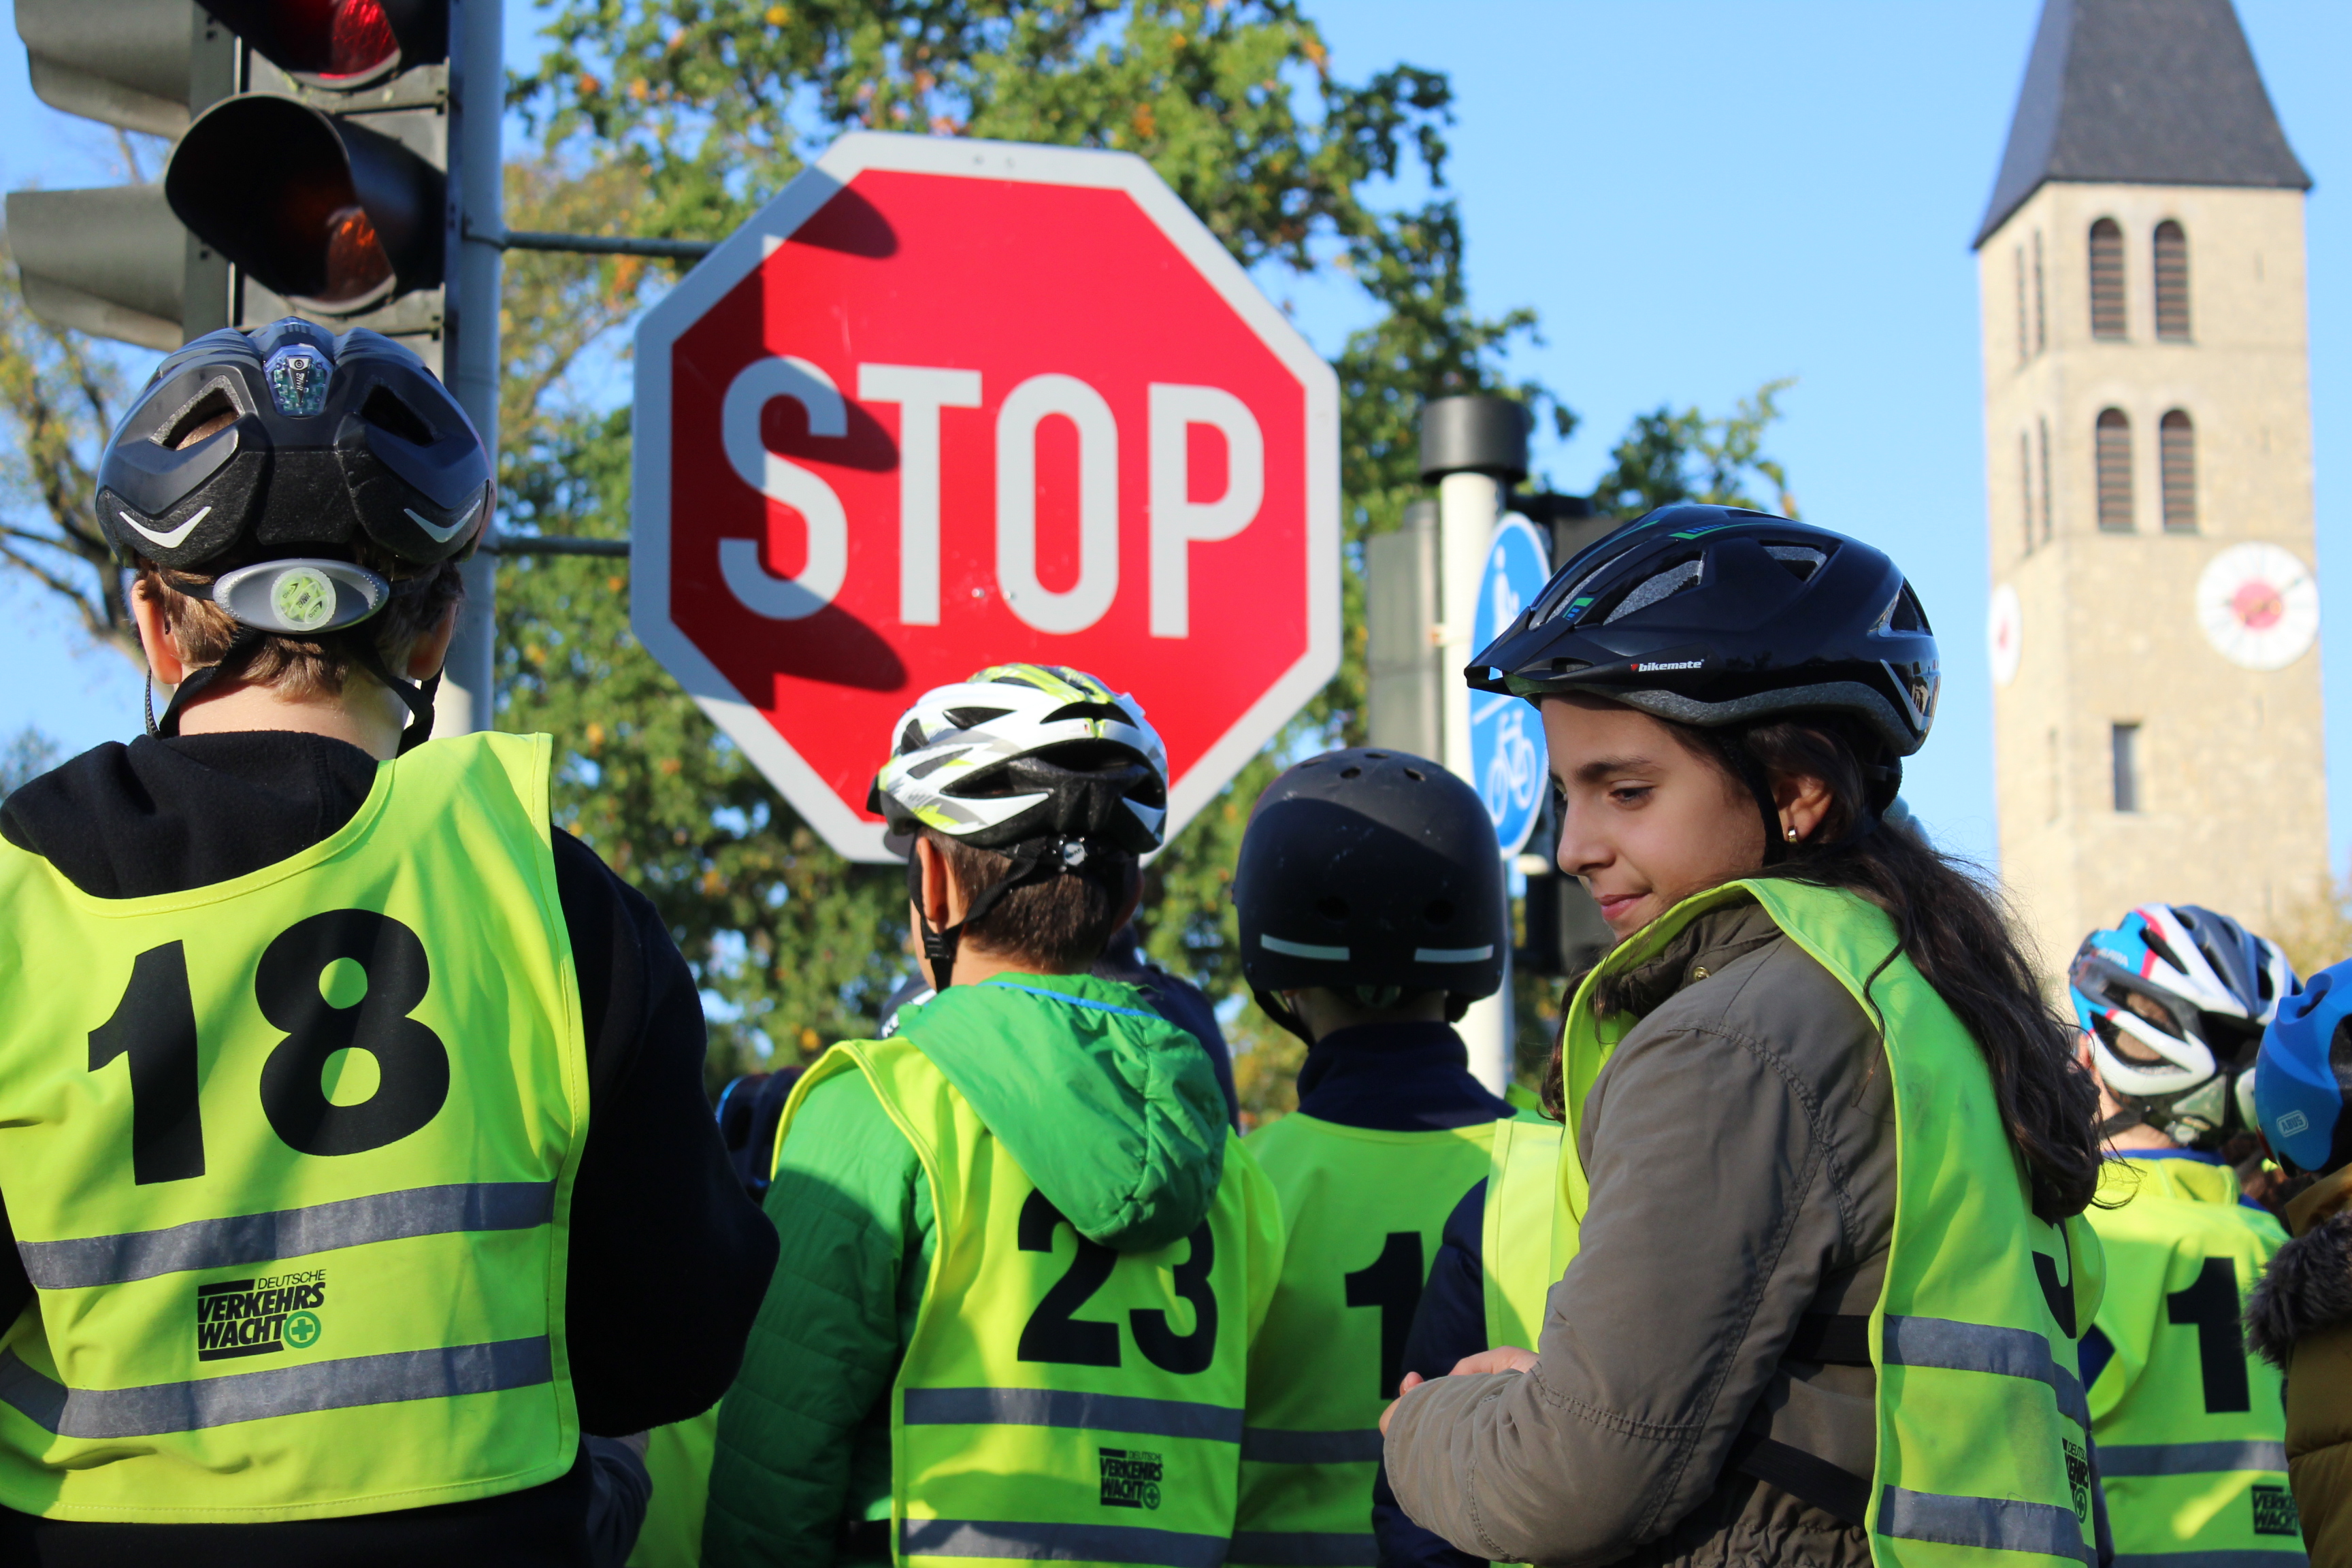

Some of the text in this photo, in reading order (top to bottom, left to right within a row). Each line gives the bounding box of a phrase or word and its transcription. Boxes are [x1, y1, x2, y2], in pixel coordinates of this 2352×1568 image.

[718, 355, 1265, 639] STOP
[308, 606, 320, 618] Open
[1638, 660, 1702, 672] bikemate
[87, 908, 450, 1186] 18
[258, 1269, 327, 1290] DEUTSCHE
[1017, 1187, 1218, 1375] 23
[197, 1281, 326, 1323] VERKEHRS
[197, 1313, 288, 1350] WACHT
[1100, 1456, 1163, 1482] VERKEHRS
[1100, 1476, 1144, 1499] WACHT
